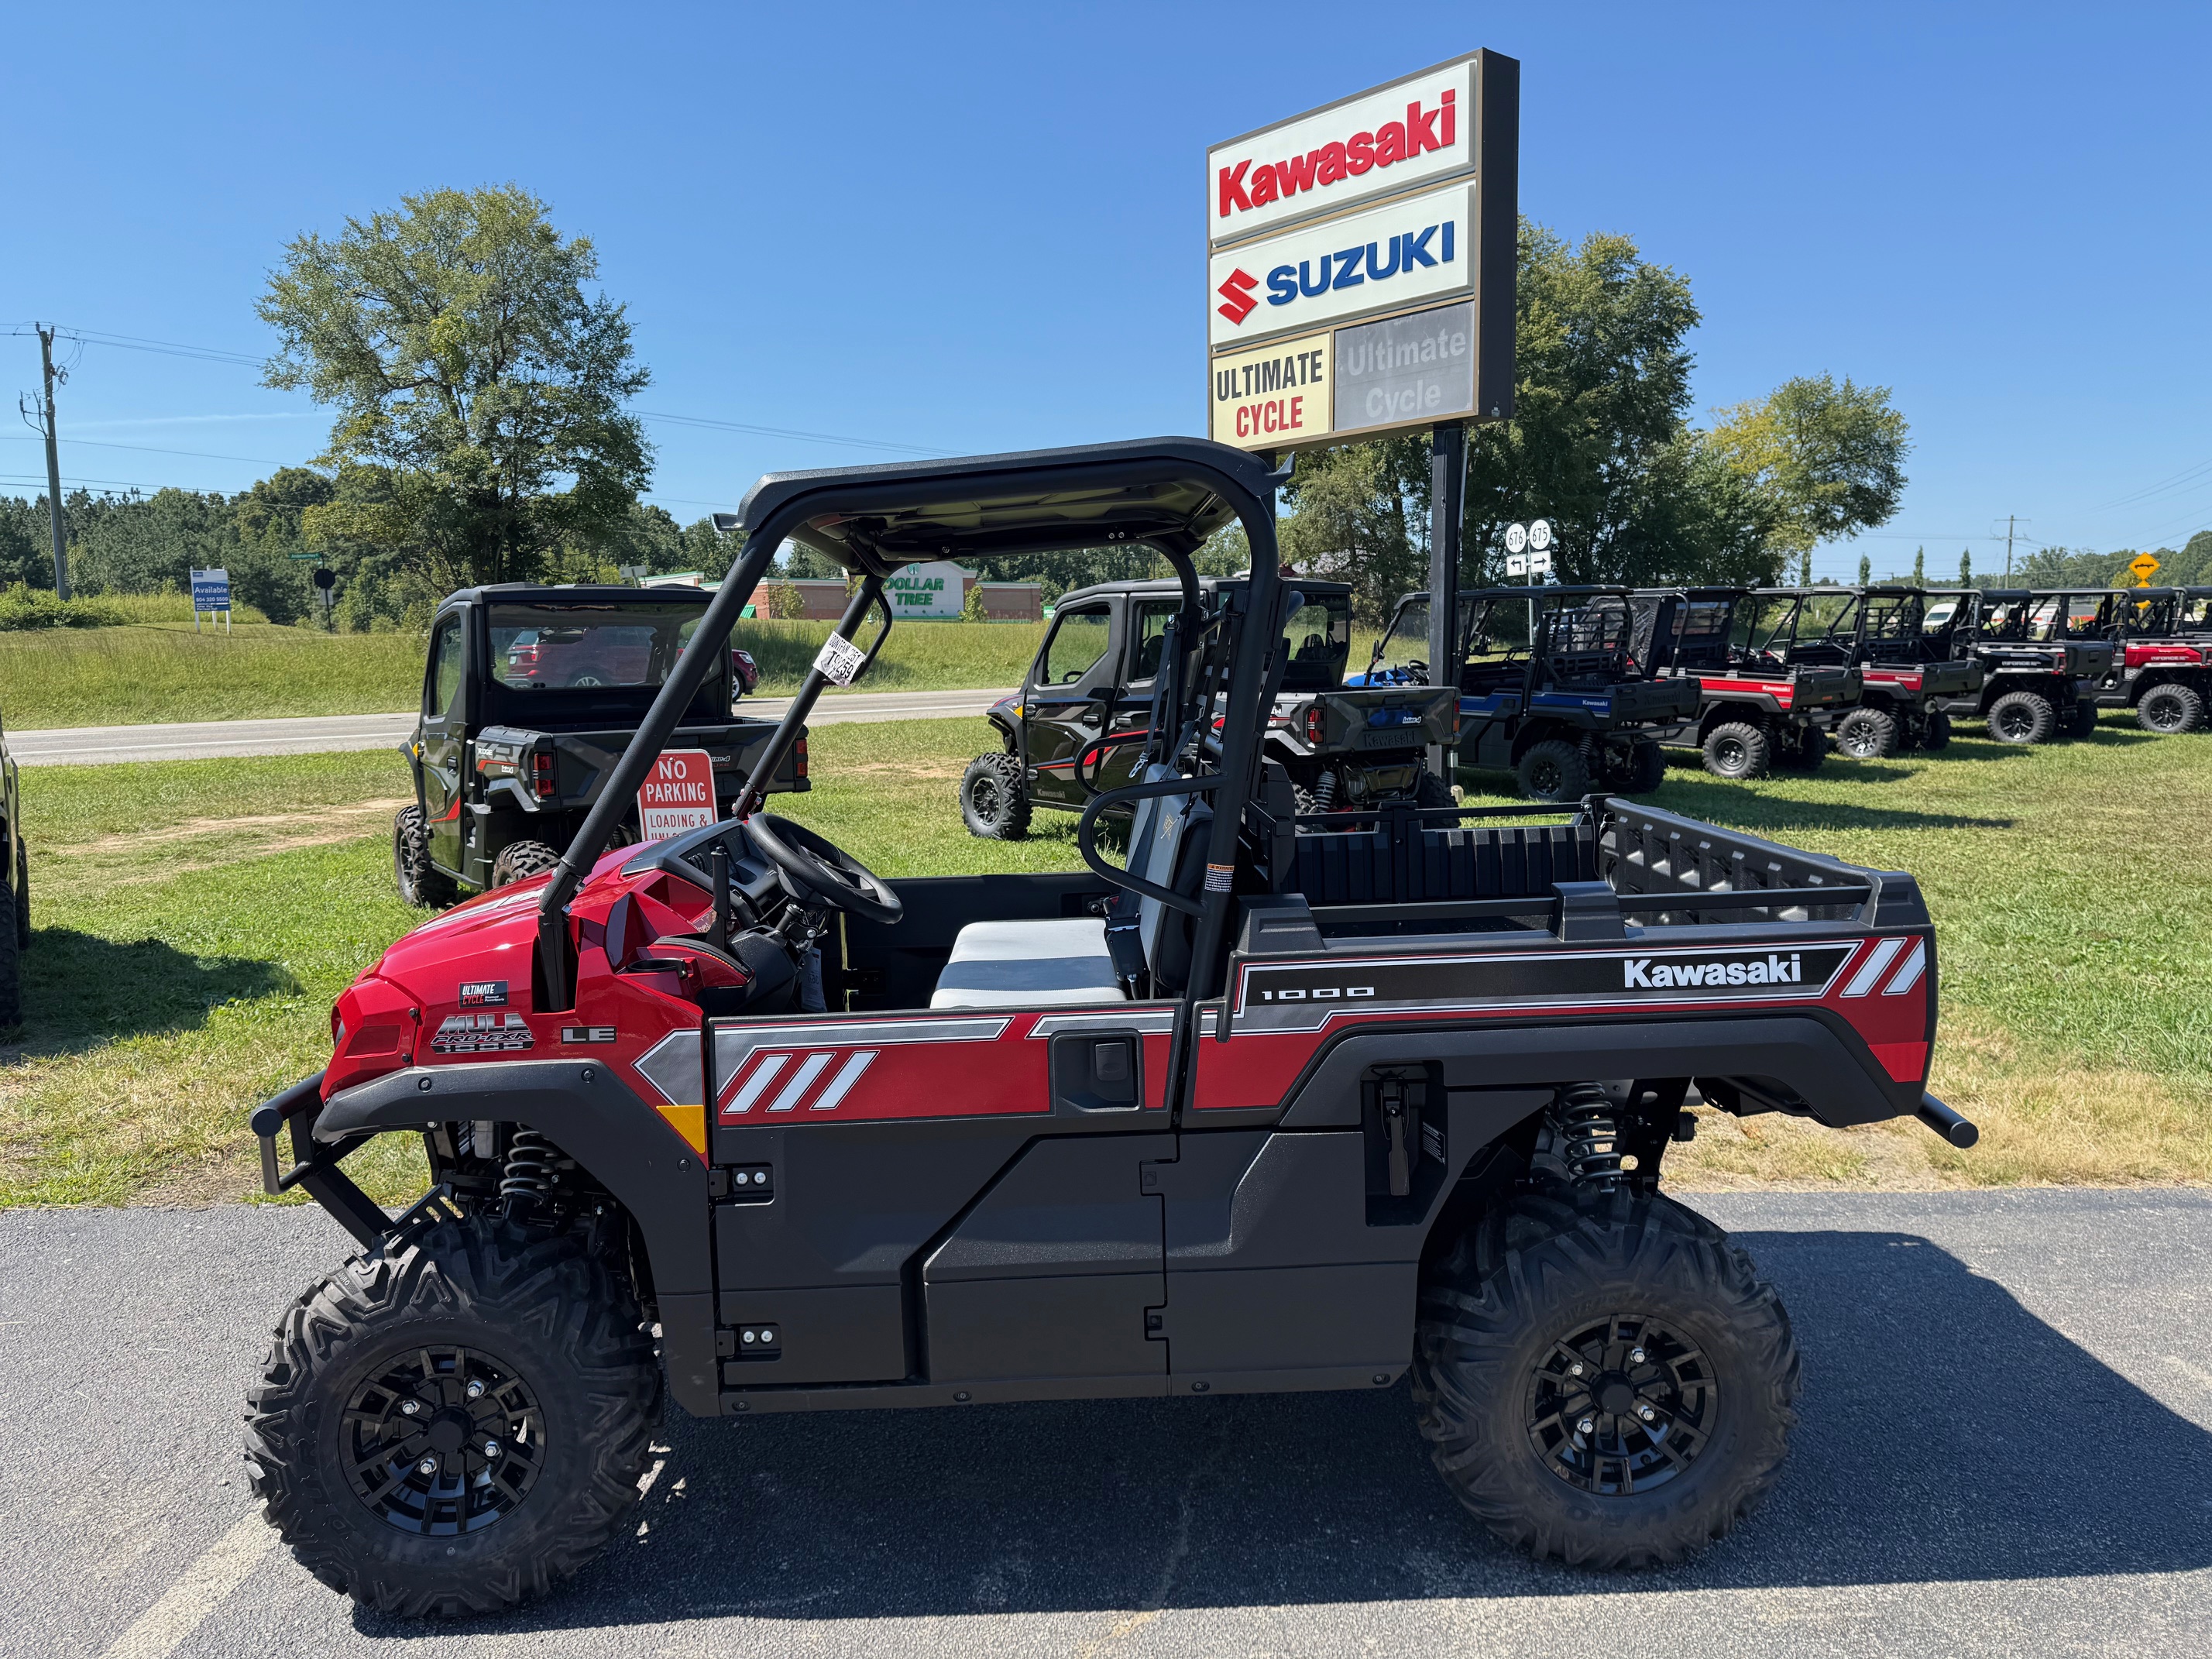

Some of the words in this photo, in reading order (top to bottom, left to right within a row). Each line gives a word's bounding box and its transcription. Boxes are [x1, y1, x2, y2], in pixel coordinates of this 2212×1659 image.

[1219, 88, 1456, 218] Kawasaki
[1266, 220, 1455, 306] SUZUKI
[1348, 328, 1466, 376] Ultimate
[1217, 349, 1323, 402] ULTIMATE
[1365, 380, 1441, 423] Cycle
[1236, 396, 1303, 438] CYCLE
[1509, 531, 1523, 546] 676
[1532, 527, 1547, 542] 675
[895, 592, 934, 606] TREE
[1365, 731, 1417, 747] Kawasaki
[658, 760, 687, 779] NO
[646, 782, 706, 802] PARKING
[1036, 788, 1066, 799] Kawasaki
[650, 814, 695, 828] LOADING
[699, 814, 707, 826] &
[1624, 954, 1802, 988] Kawasaki
[462, 984, 495, 995] ULTIMATE
[1262, 988, 1376, 1000] 1000
[462, 994, 484, 1005] CYCLE
[435, 1013, 531, 1036] MULE
[431, 1032, 533, 1044] PRO-FXR
[562, 1028, 615, 1042] LE
[443, 1042, 524, 1053] 1000
